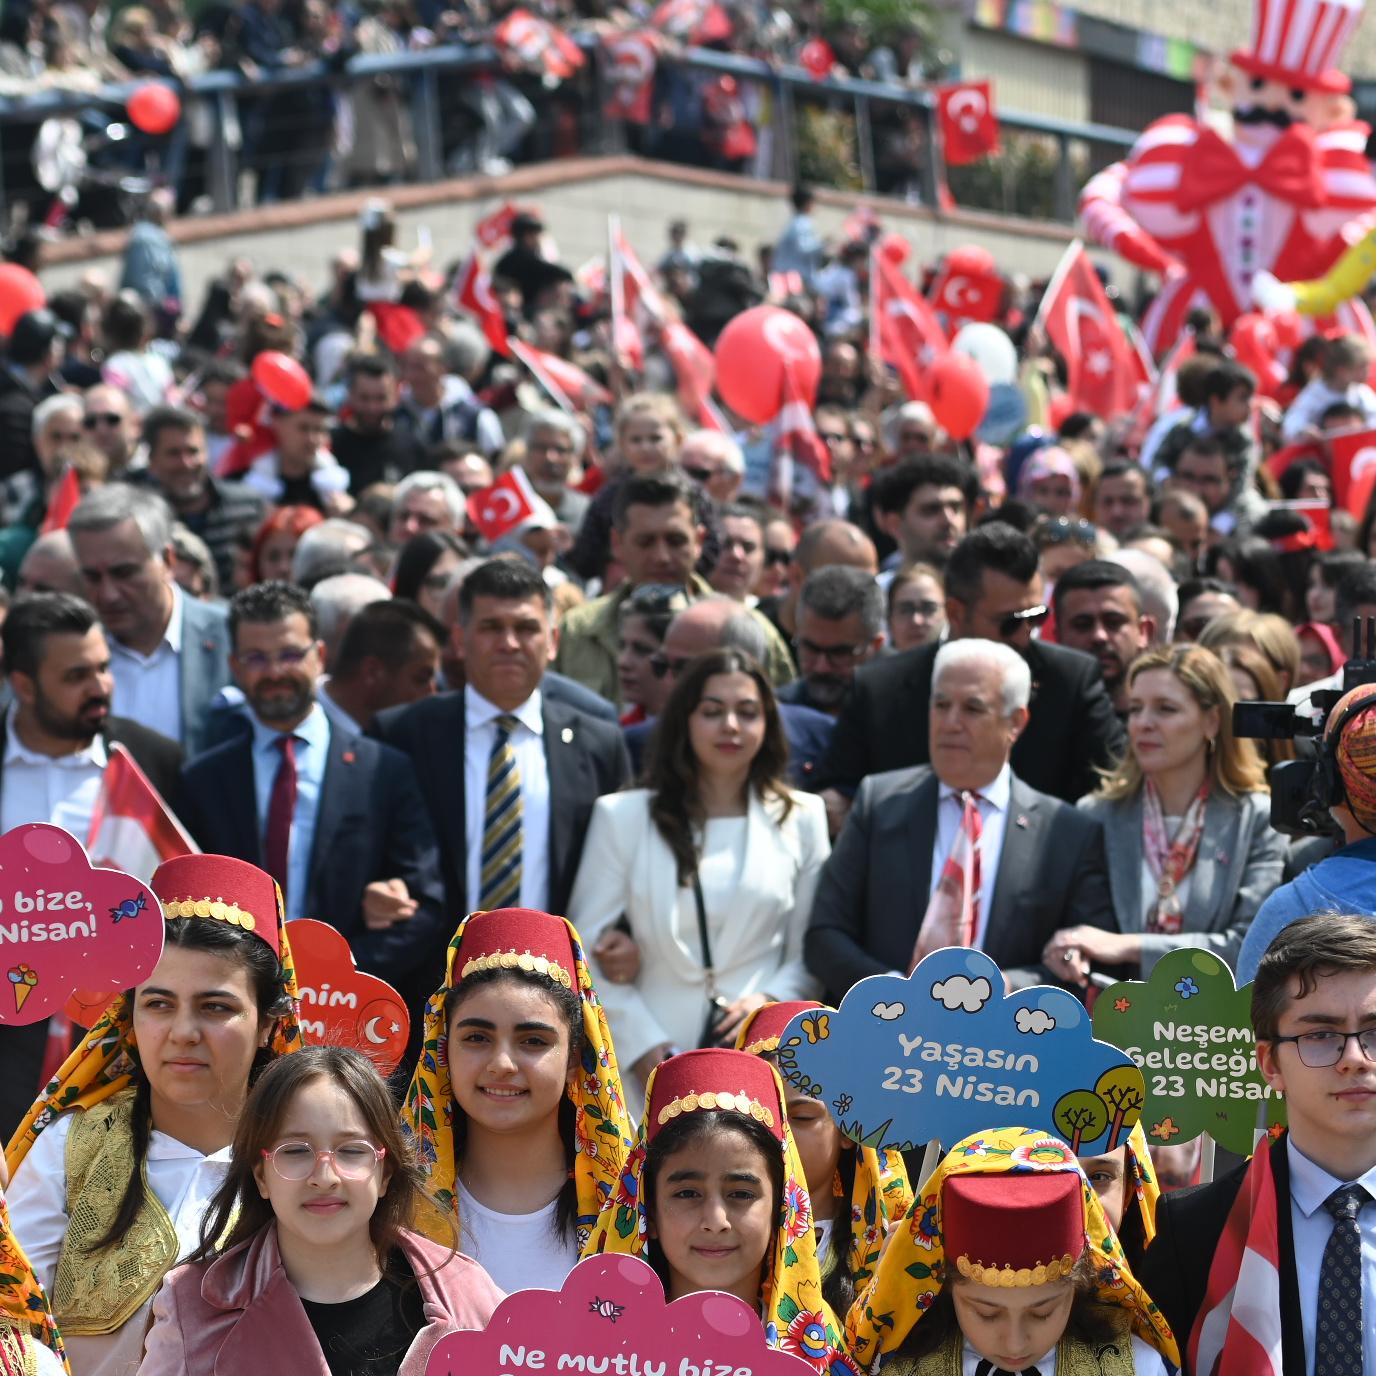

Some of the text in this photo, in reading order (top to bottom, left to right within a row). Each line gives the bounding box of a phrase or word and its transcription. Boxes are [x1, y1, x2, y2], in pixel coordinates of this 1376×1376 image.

[14, 889, 93, 913] bize,
[297, 983, 357, 1009] nim
[1153, 1021, 1256, 1049] Neşem
[897, 1033, 1039, 1073] Yaşasın
[1124, 1046, 1257, 1078] Geleceği
[881, 1065, 1040, 1108] 23 Nisan
[1151, 1075, 1186, 1097] 23
[498, 1344, 545, 1370] Ne
